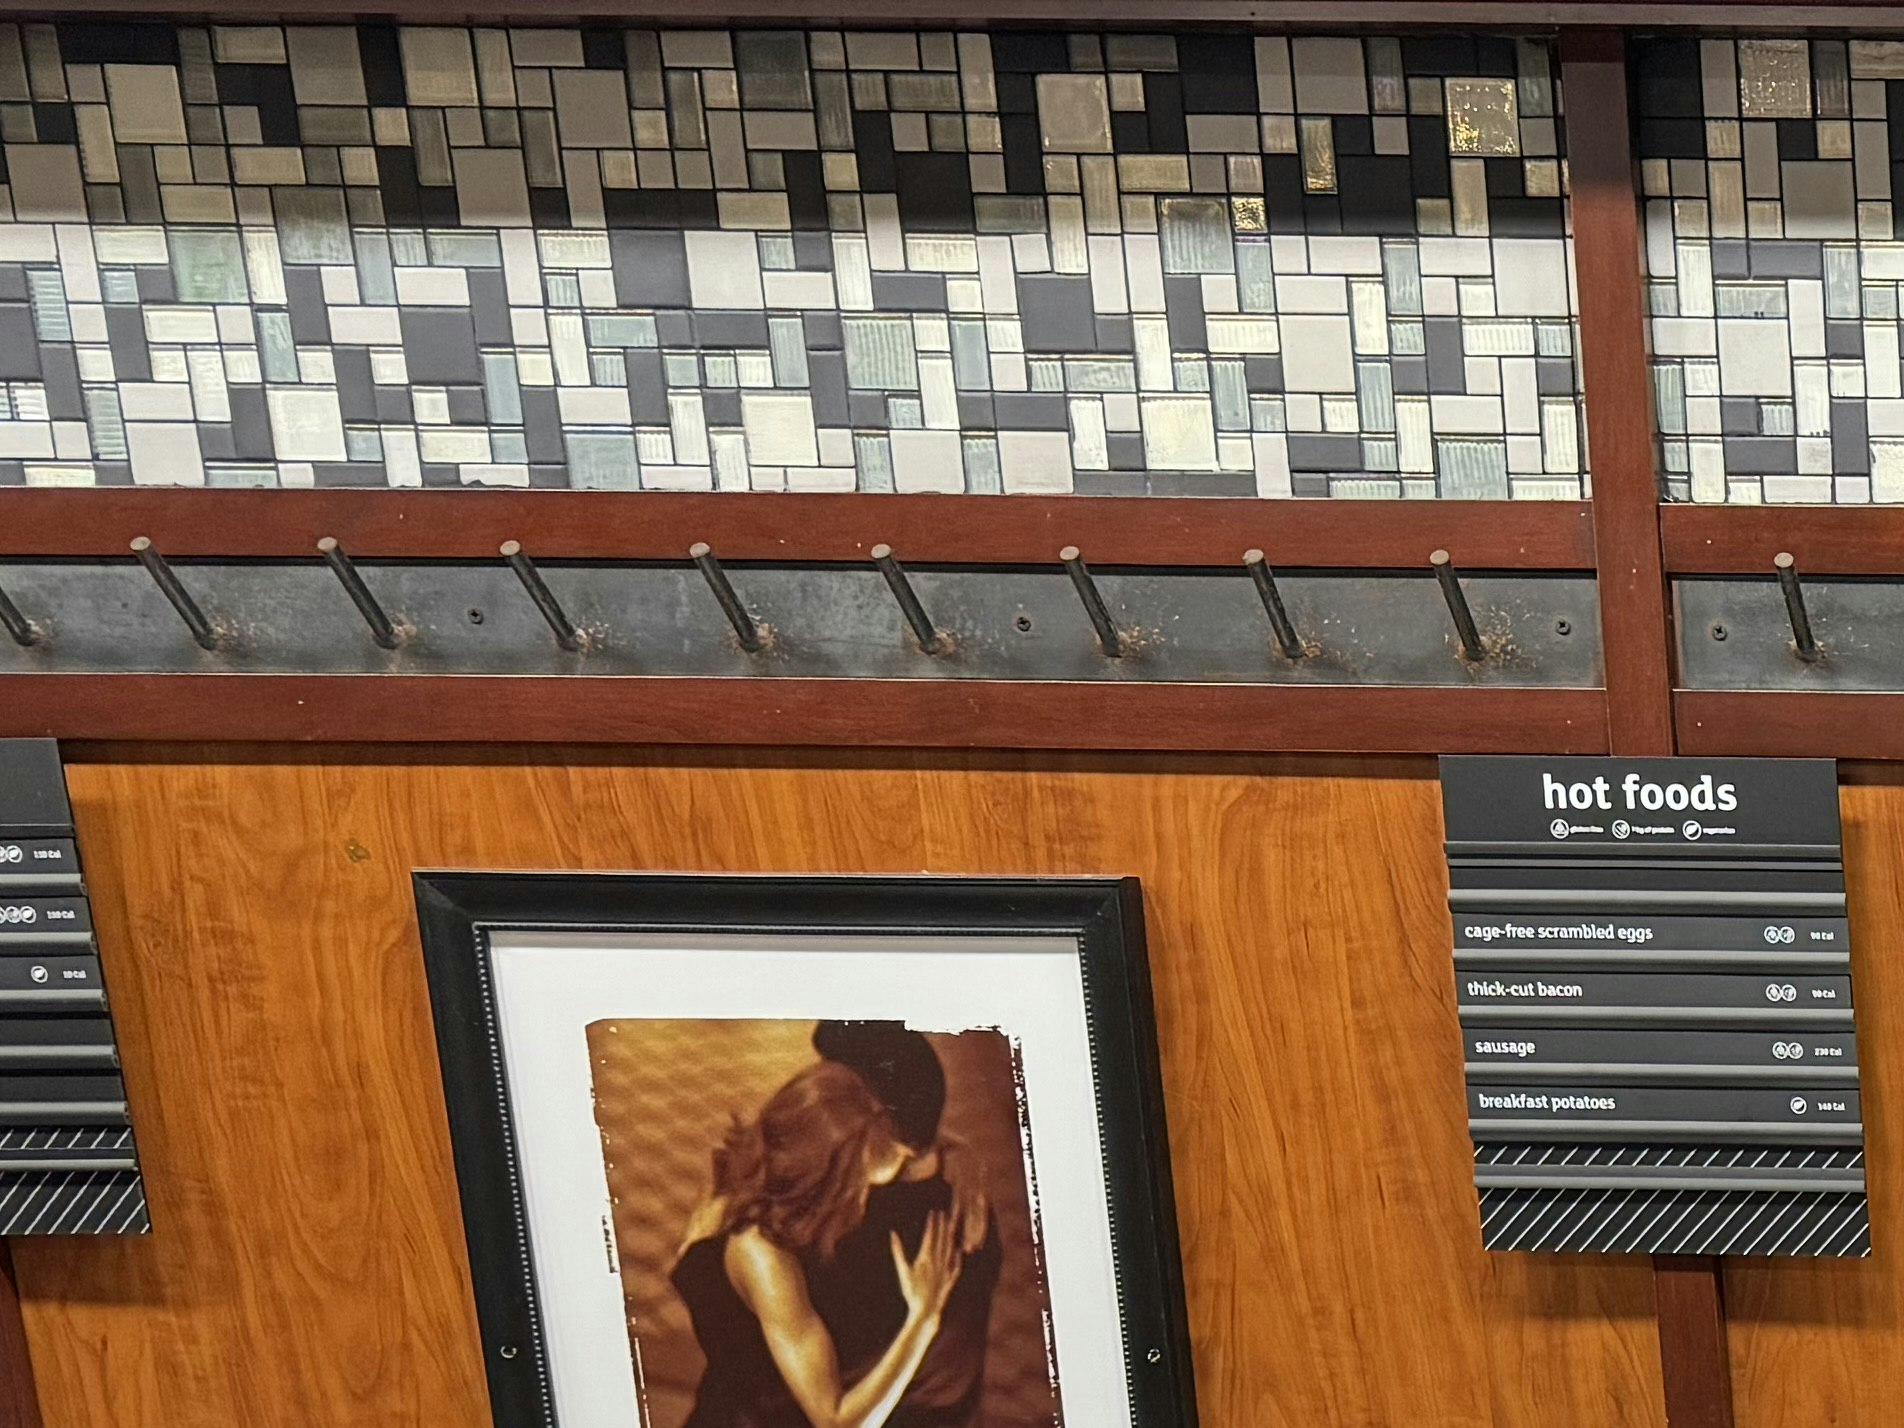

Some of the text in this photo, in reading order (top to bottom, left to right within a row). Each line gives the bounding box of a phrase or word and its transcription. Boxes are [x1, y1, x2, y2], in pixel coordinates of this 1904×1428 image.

[1542, 773, 1738, 811] hot foods
[1464, 923, 1654, 943] cage-free scrambled eggs
[1467, 981, 1583, 997] thick-cut bacon
[1475, 1041, 1536, 1057] sausage
[1478, 1093, 1616, 1113] breakfast potatoes
